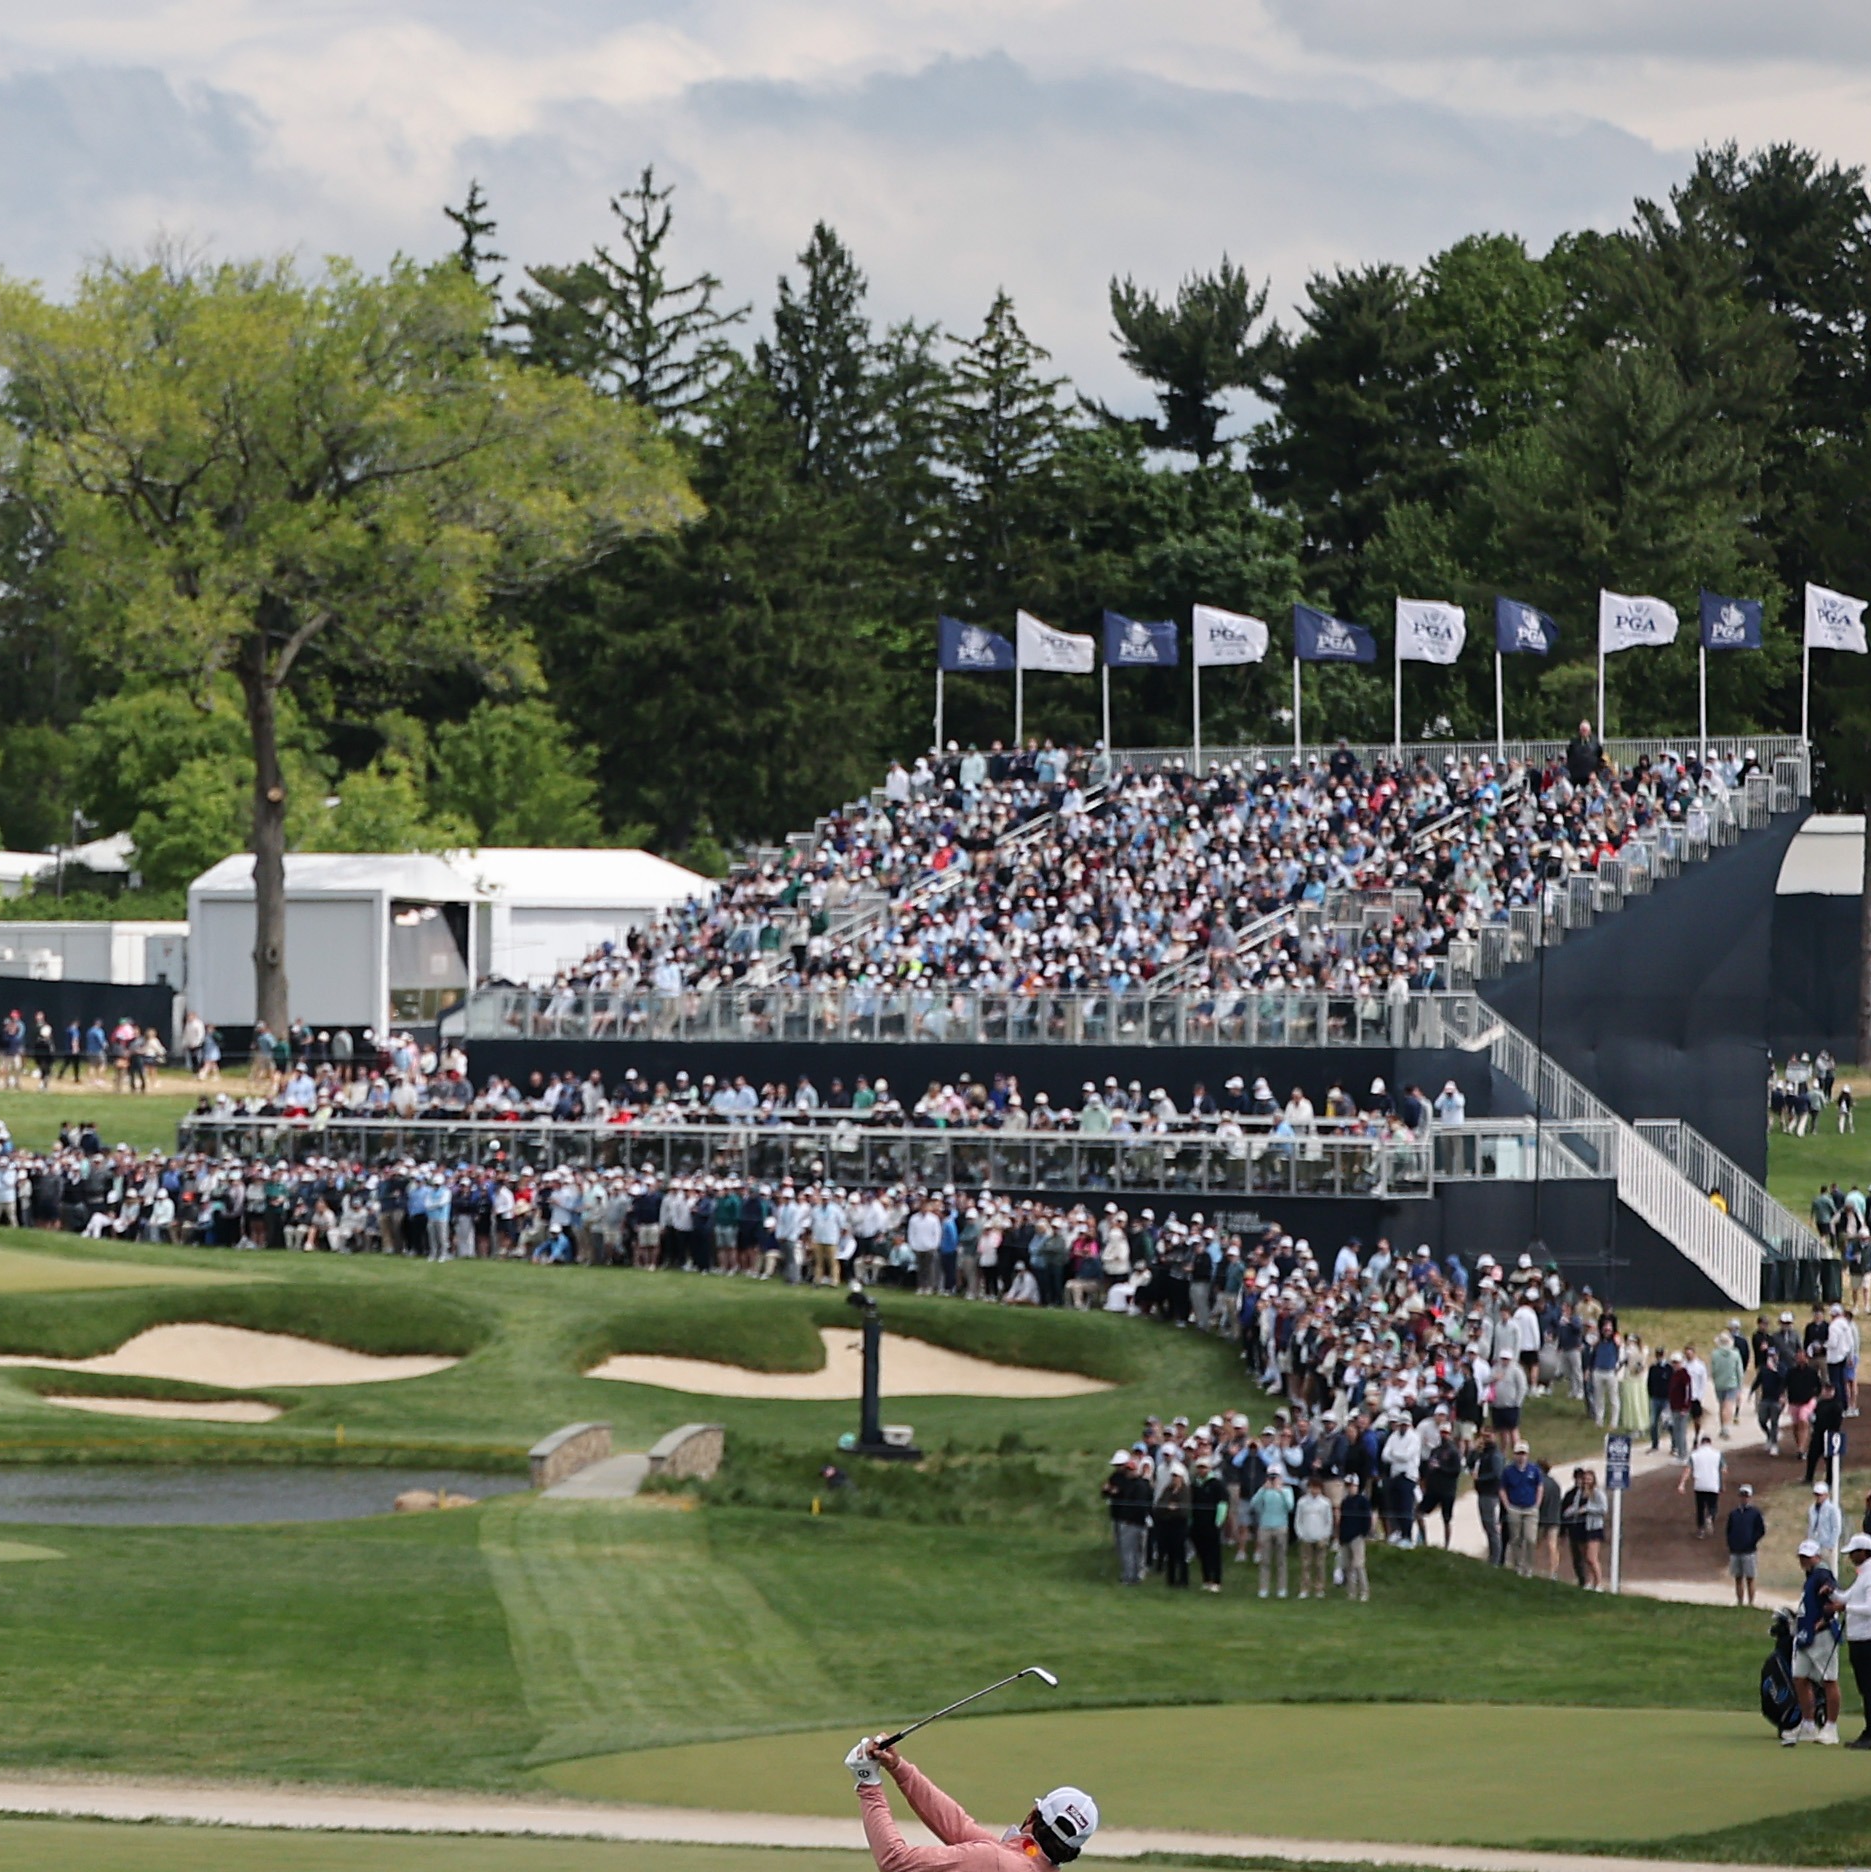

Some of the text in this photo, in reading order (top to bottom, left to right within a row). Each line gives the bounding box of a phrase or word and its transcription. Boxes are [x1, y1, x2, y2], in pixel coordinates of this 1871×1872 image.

[1616, 615, 1656, 632] PGA
[1817, 608, 1851, 625] PGA
[1209, 628, 1247, 642] PGA
[1413, 623, 1454, 641] PGA
[1517, 625, 1547, 644] PGA
[1712, 622, 1745, 639] PGA
[1120, 640, 1158, 657] PGA
[1317, 634, 1356, 650] PGA
[1831, 1432, 1841, 1454] 9
